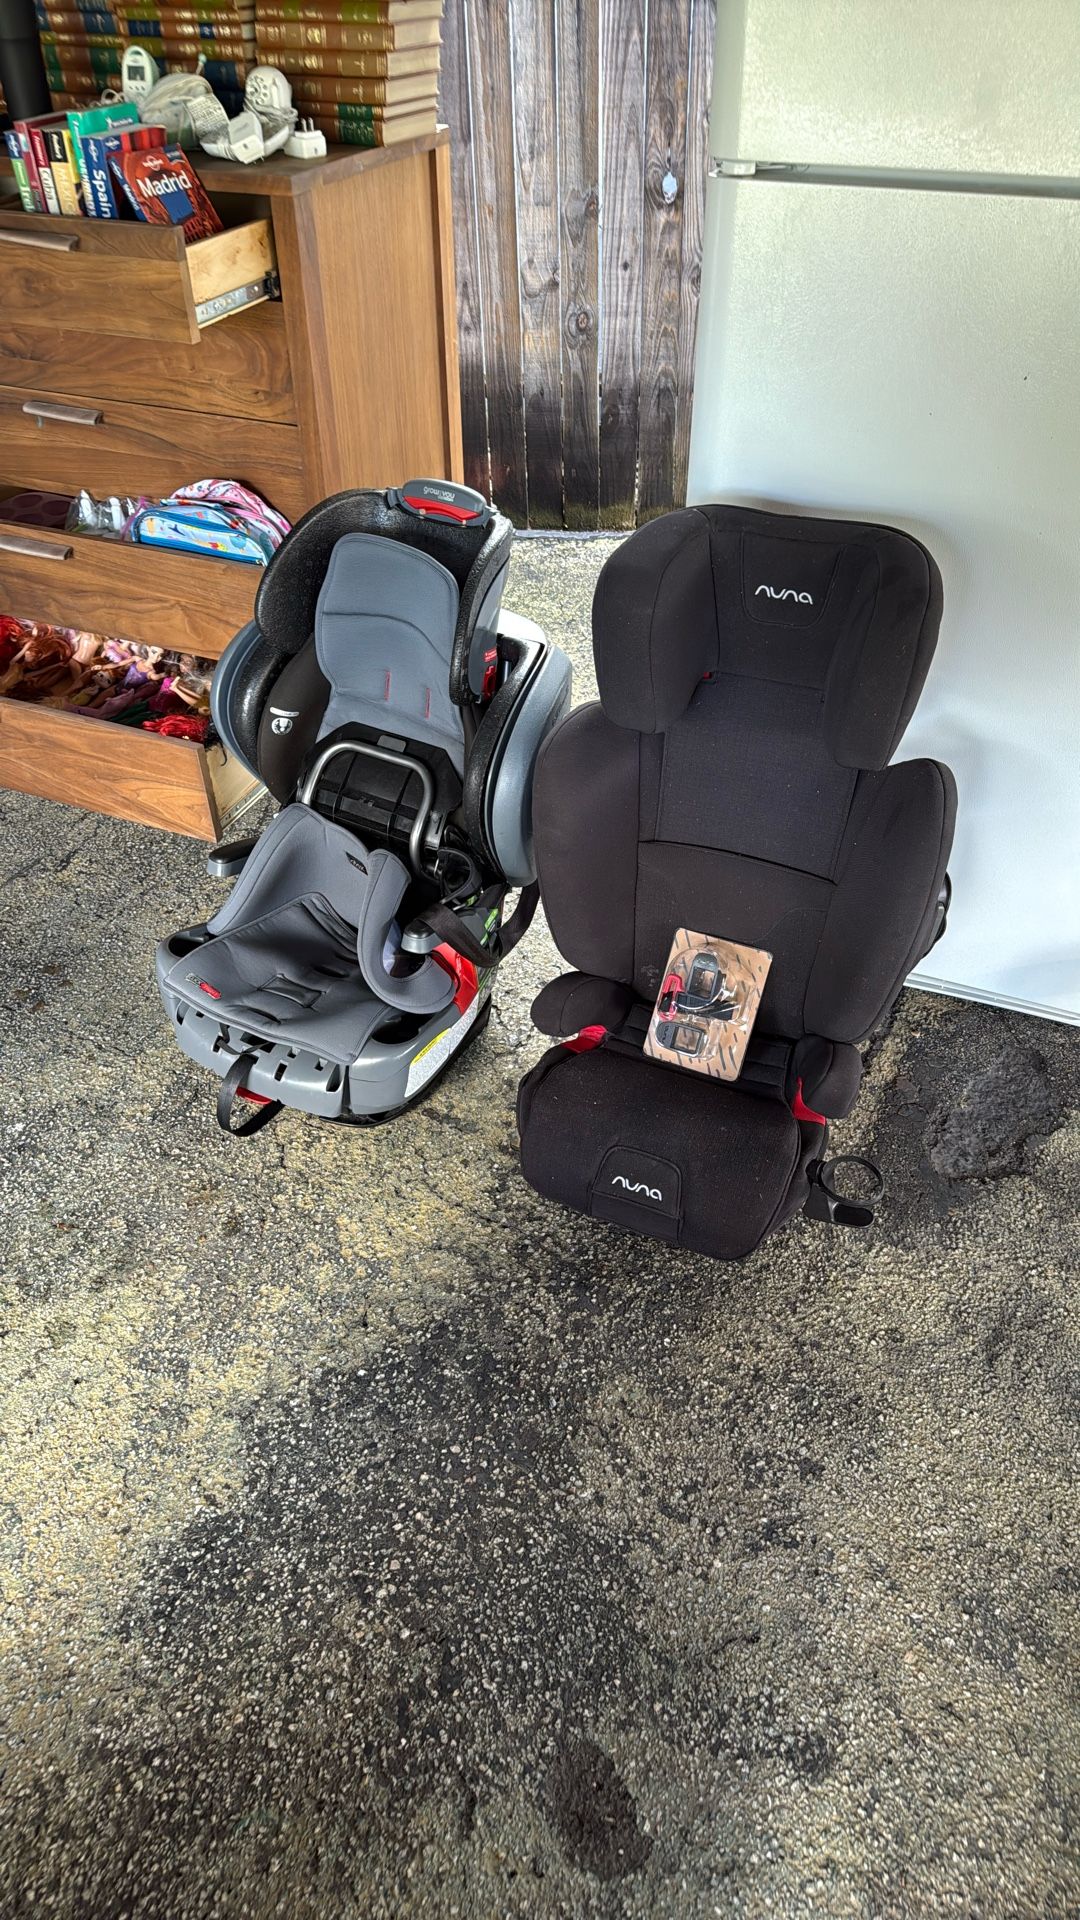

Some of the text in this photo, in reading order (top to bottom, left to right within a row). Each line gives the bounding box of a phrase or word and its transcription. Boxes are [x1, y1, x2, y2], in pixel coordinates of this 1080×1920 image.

[92, 169, 112, 218] Spain
[136, 169, 192, 199] Madrid
[423, 486, 440, 496] grow
[442, 490, 456, 499] you
[754, 584, 814, 605] nuna
[611, 1175, 662, 1202] nuna
